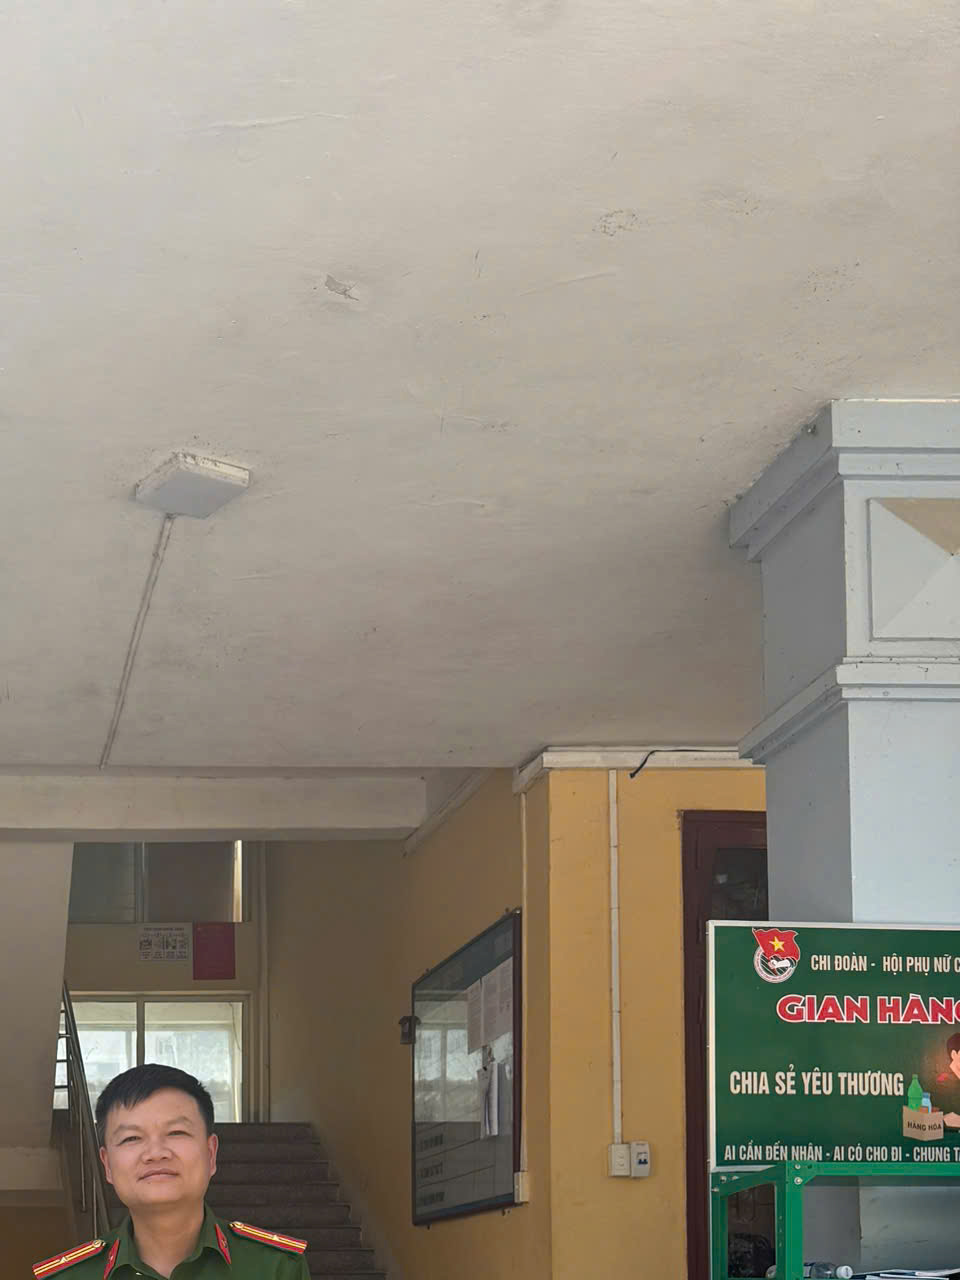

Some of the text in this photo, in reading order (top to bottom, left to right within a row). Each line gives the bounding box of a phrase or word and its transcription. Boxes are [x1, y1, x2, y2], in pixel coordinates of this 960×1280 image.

[811, 955, 831, 971] CHI
[834, 952, 867, 971] ĐOÀN
[883, 953, 902, 975] HỘI
[906, 956, 930, 976] PHỤ
[934, 954, 951, 973] NỮ
[776, 994, 870, 1023] GIAN
[729, 1064, 904, 1096] CHIA SẺ YÊU THƯƠNG
[724, 1145, 735, 1160] AI
[765, 1140, 788, 1160] ĐẾN
[791, 1143, 823, 1161] NHÂN
[833, 1146, 844, 1161] AI
[847, 1143, 863, 1161] CÓ
[866, 1146, 888, 1161] CHO
[891, 1146, 902, 1161] ĐI
[913, 1146, 951, 1162] CHUNG
[953, 1147, 960, 1162] T
